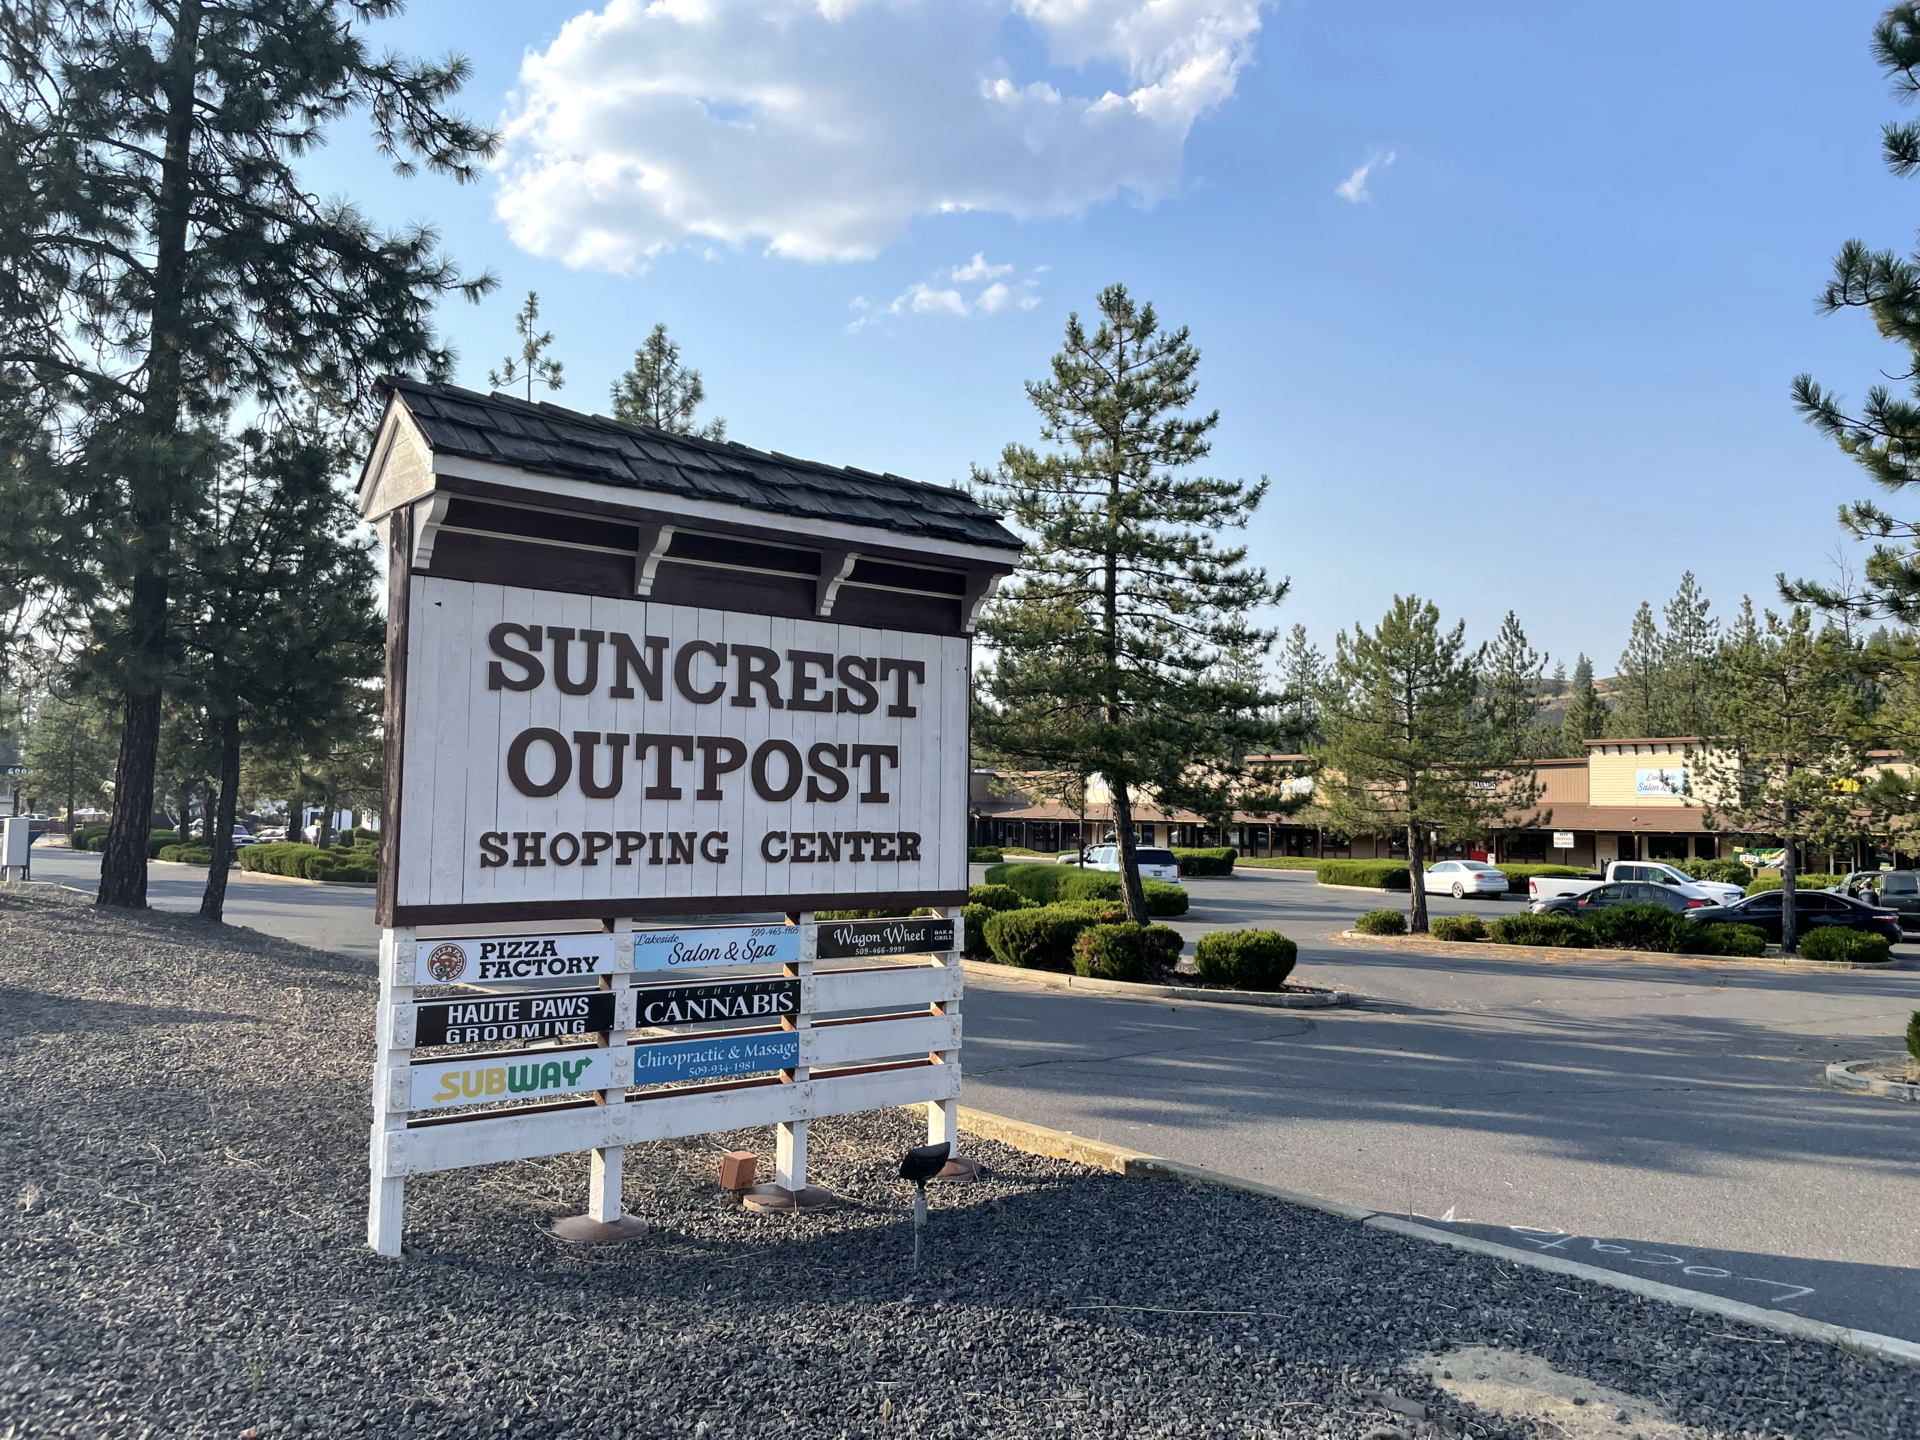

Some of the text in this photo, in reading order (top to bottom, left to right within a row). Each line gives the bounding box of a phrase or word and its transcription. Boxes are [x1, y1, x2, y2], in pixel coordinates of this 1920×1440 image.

[488, 622, 925, 718] SUNCREST
[507, 727, 899, 803] OUTPOST
[480, 831, 922, 869] SHOPPING CENTER
[636, 933, 680, 946] Lakeside
[833, 924, 926, 946] Wagon Wheel
[432, 947, 452, 962] PIZZA
[480, 940, 558, 959] PIZZA
[668, 938, 777, 965] Salon & Spa
[855, 945, 906, 956] 509-466-9991
[478, 955, 600, 979] FACTORY
[448, 997, 590, 1024] HAUTE PAWS
[644, 991, 794, 1024] CANNABIS
[445, 1019, 586, 1044] GROOMING
[637, 1042, 798, 1071] Chiropractic & Massage
[688, 1061, 756, 1077] 509-934-1981
[432, 1056, 593, 1102] SUBWAY
